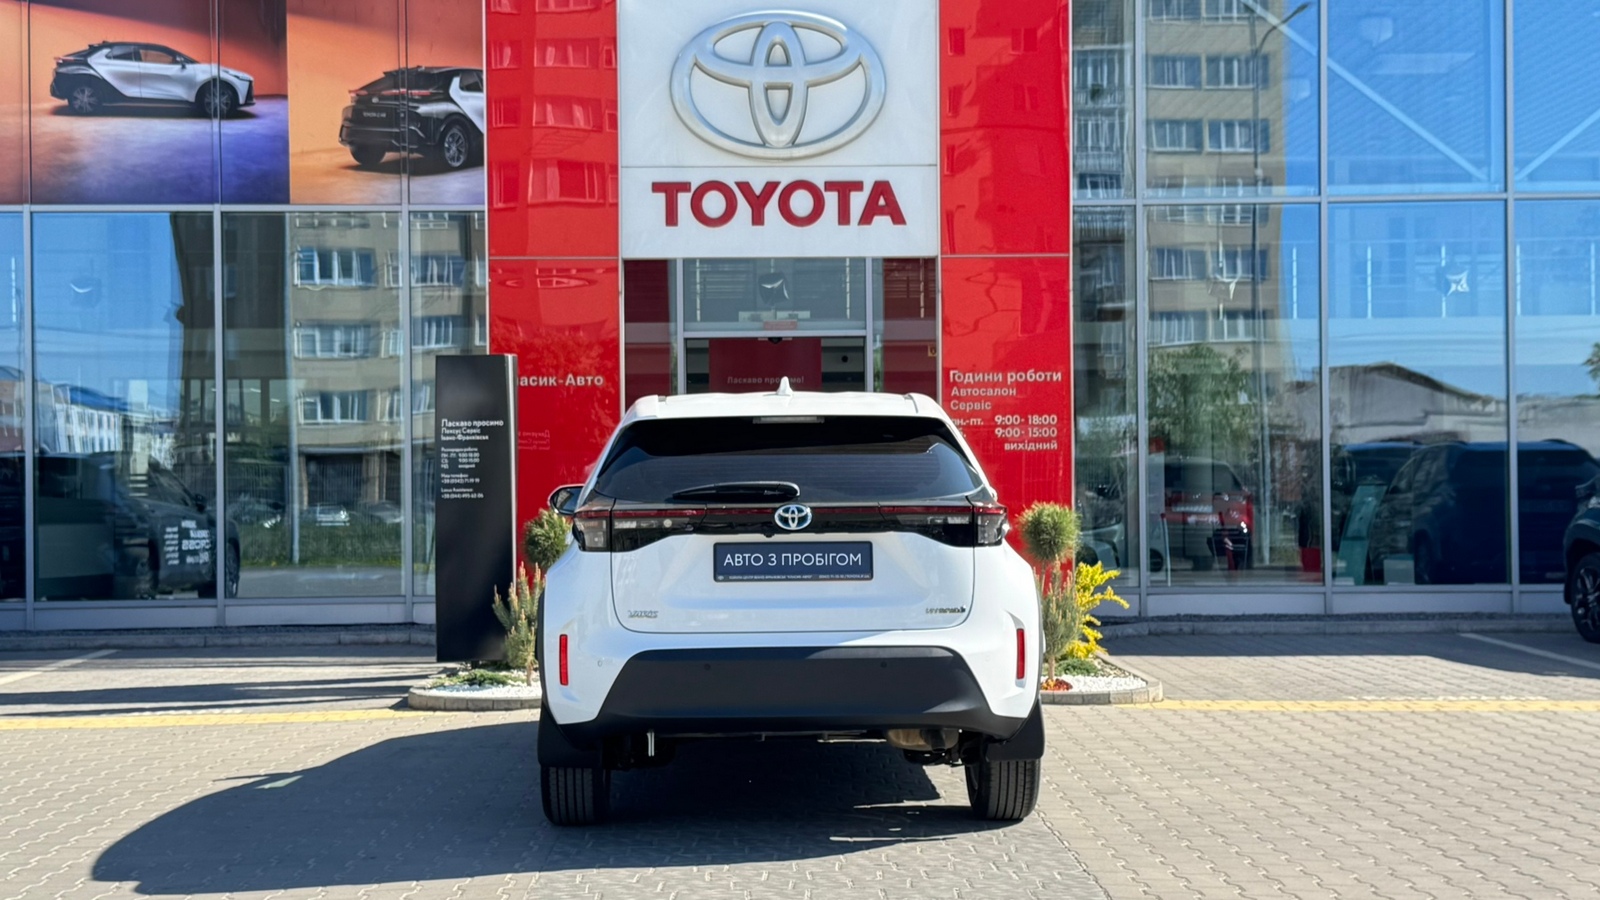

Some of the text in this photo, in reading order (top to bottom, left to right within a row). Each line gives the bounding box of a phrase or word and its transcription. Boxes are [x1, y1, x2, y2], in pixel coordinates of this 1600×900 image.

[651, 179, 908, 228] TOYOTA
[517, 373, 604, 387] асик-Авто
[764, 376, 804, 386] промо!
[949, 369, 1062, 385] Години роботи
[951, 386, 1017, 397] Автосалон
[950, 400, 992, 413] Сервіс
[1004, 440, 1058, 451] вихідний
[723, 553, 862, 567] АВТО З ПРОБІГОМ
